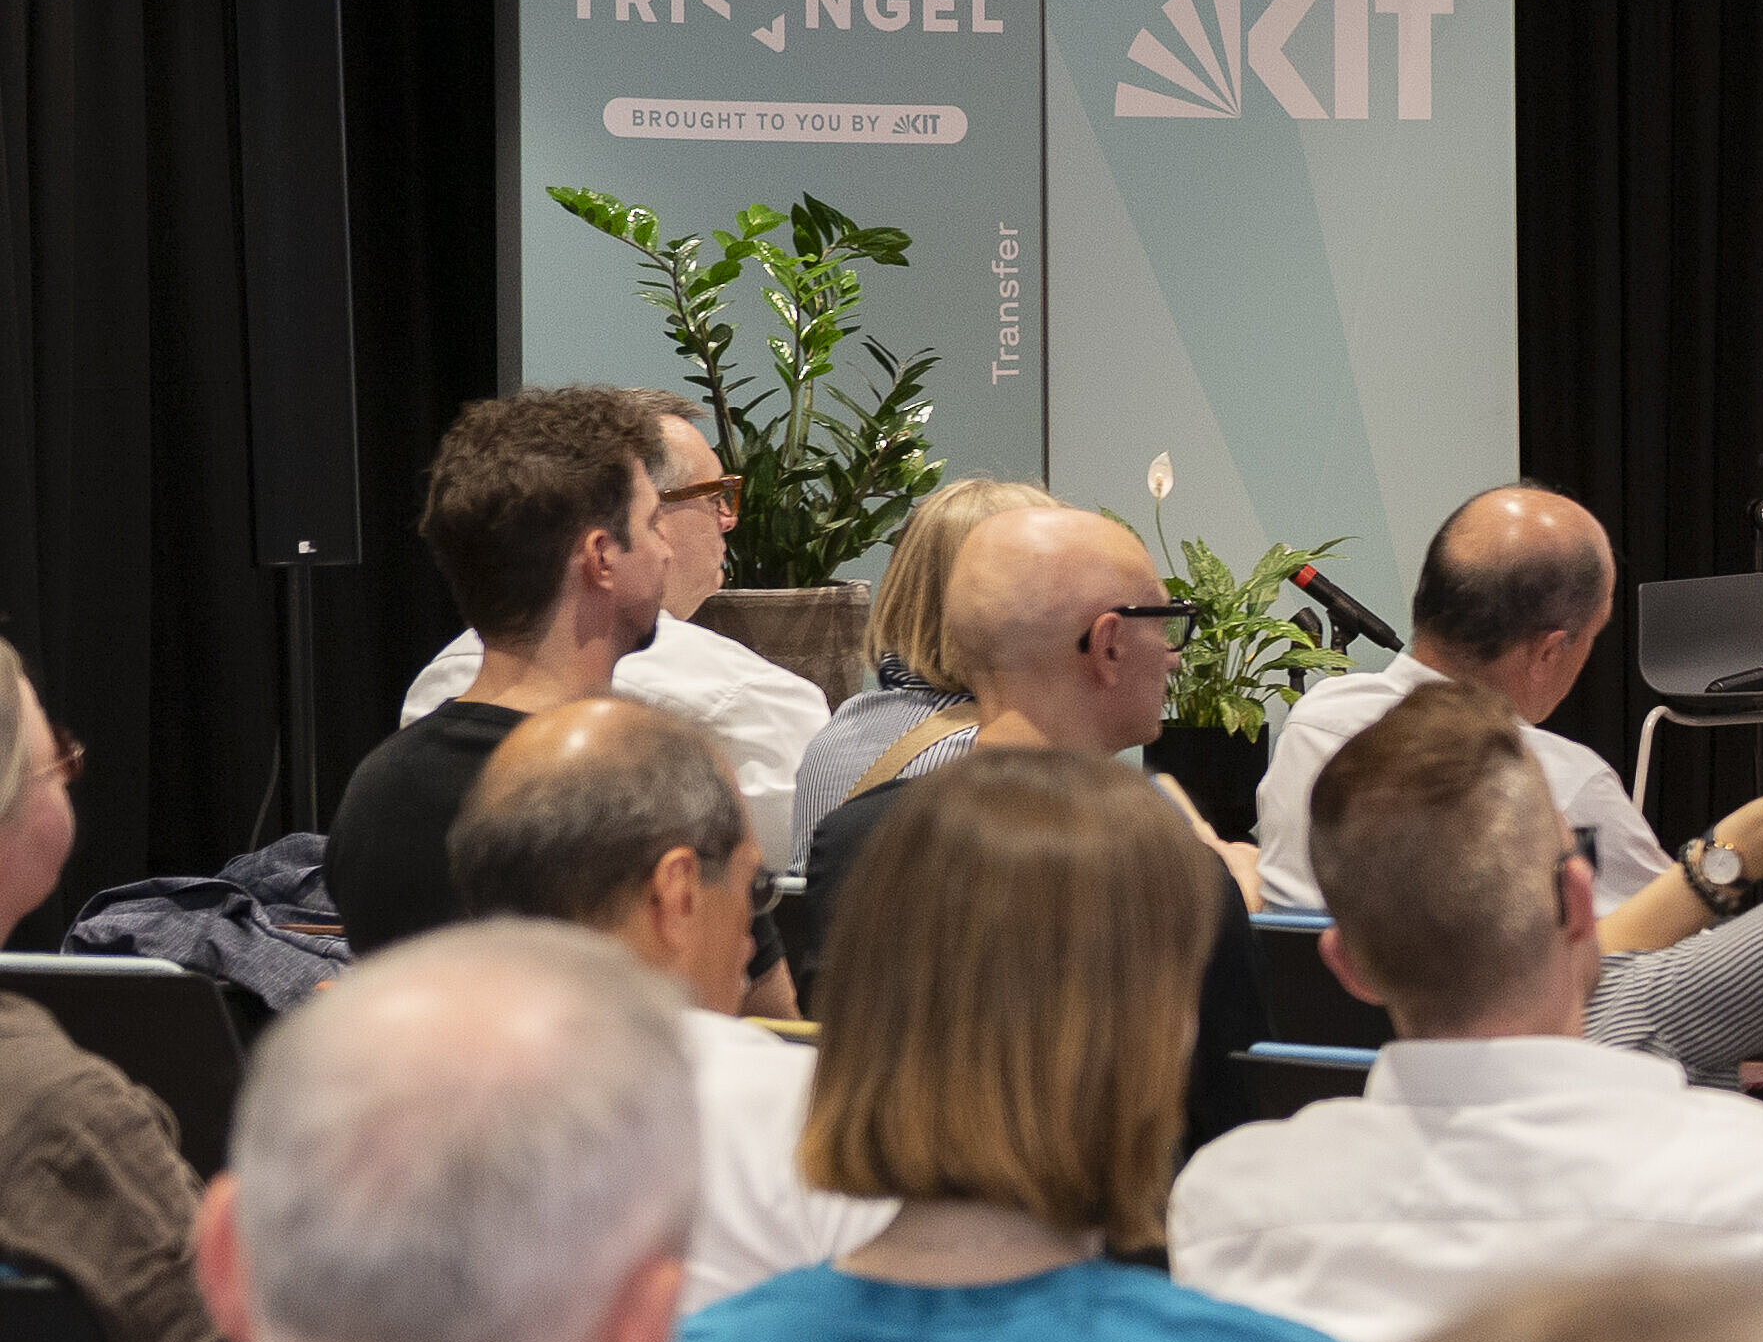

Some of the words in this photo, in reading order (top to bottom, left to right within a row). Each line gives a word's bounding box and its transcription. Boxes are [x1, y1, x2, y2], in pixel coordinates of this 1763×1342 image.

[631, 109, 746, 130] BROUGHT
[756, 112, 786, 131] TO
[796, 113, 842, 132] YOU
[851, 114, 881, 133] BY
[991, 221, 1020, 385] Transfer
